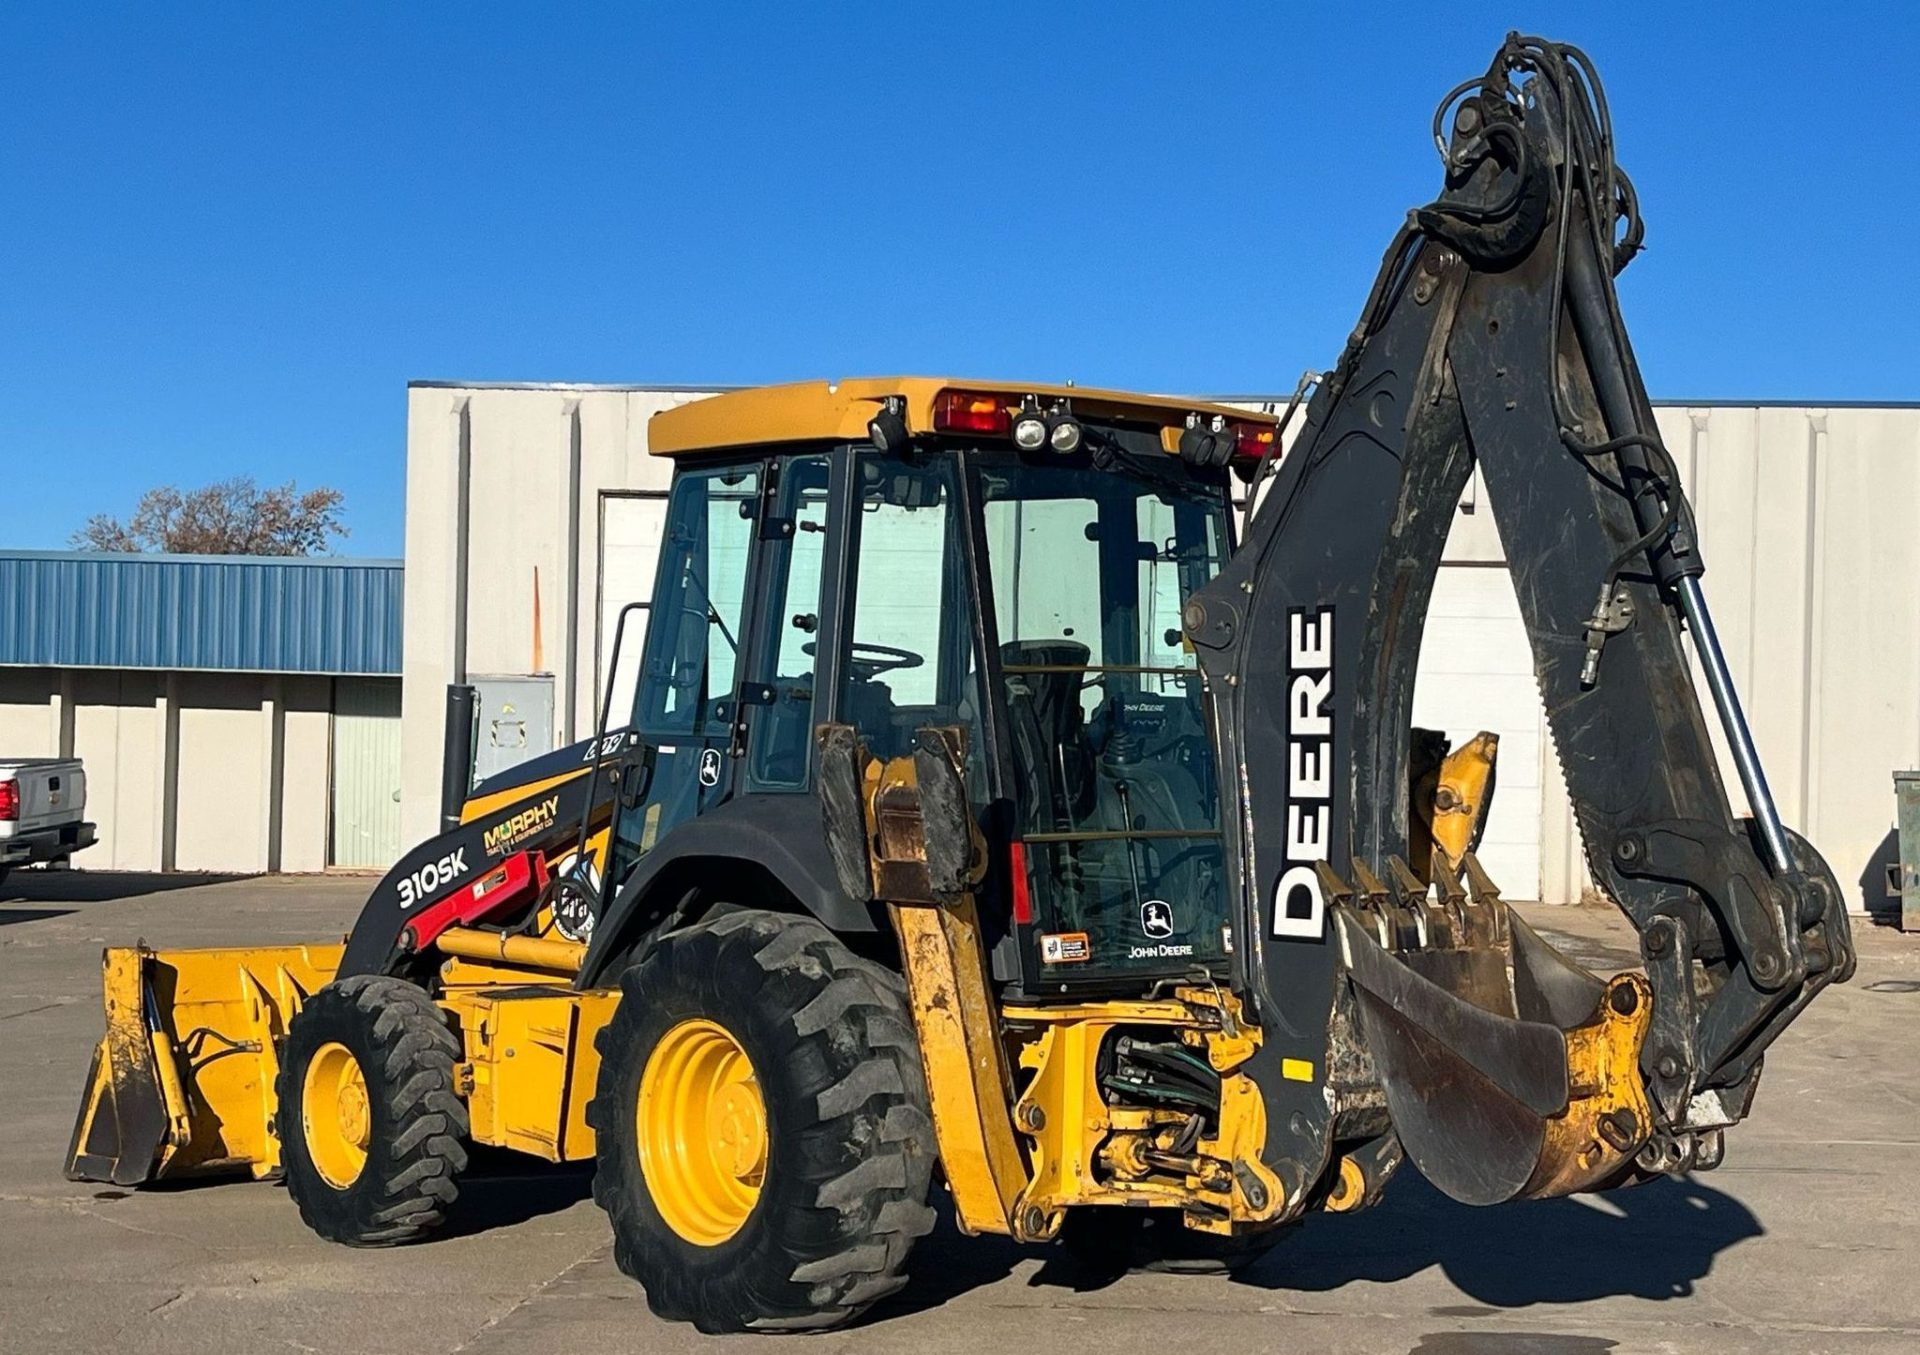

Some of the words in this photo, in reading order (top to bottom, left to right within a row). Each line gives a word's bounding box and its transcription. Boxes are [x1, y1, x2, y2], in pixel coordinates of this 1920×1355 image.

[1273, 612, 1332, 938] DEERE
[483, 795, 559, 850] MURPHY
[397, 847, 469, 908] 310SK
[1128, 946, 1158, 958] JOHN
[1159, 945, 1193, 956] DEERE
